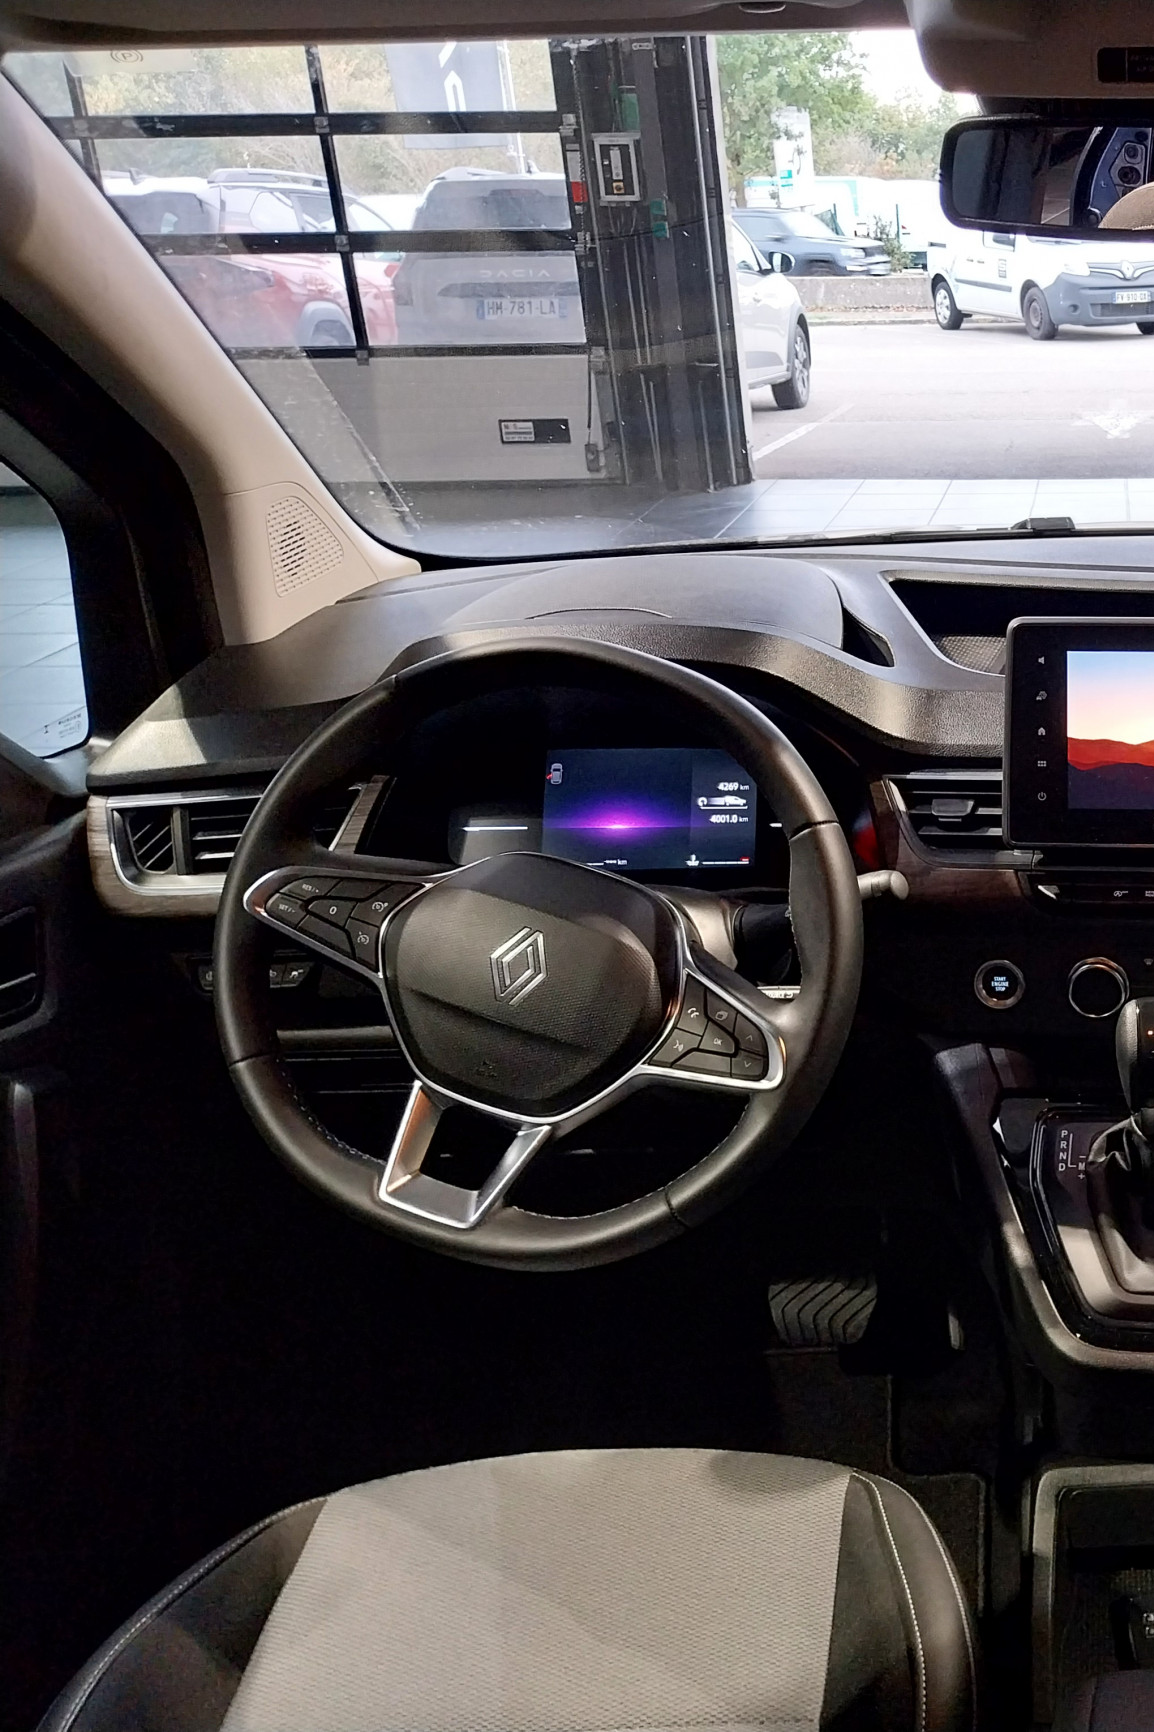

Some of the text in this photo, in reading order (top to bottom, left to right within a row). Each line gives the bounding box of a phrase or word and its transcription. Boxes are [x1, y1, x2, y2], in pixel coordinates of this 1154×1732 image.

[480, 269, 551, 278] DACIA
[717, 782, 739, 791] 4269
[709, 814, 738, 823] 4001.0
[1061, 1130, 1068, 1138] P
[1060, 1140, 1067, 1149] R
[1059, 1151, 1067, 1160] N
[1058, 1162, 1066, 1171] D
[1078, 1162, 1086, 1171] M
